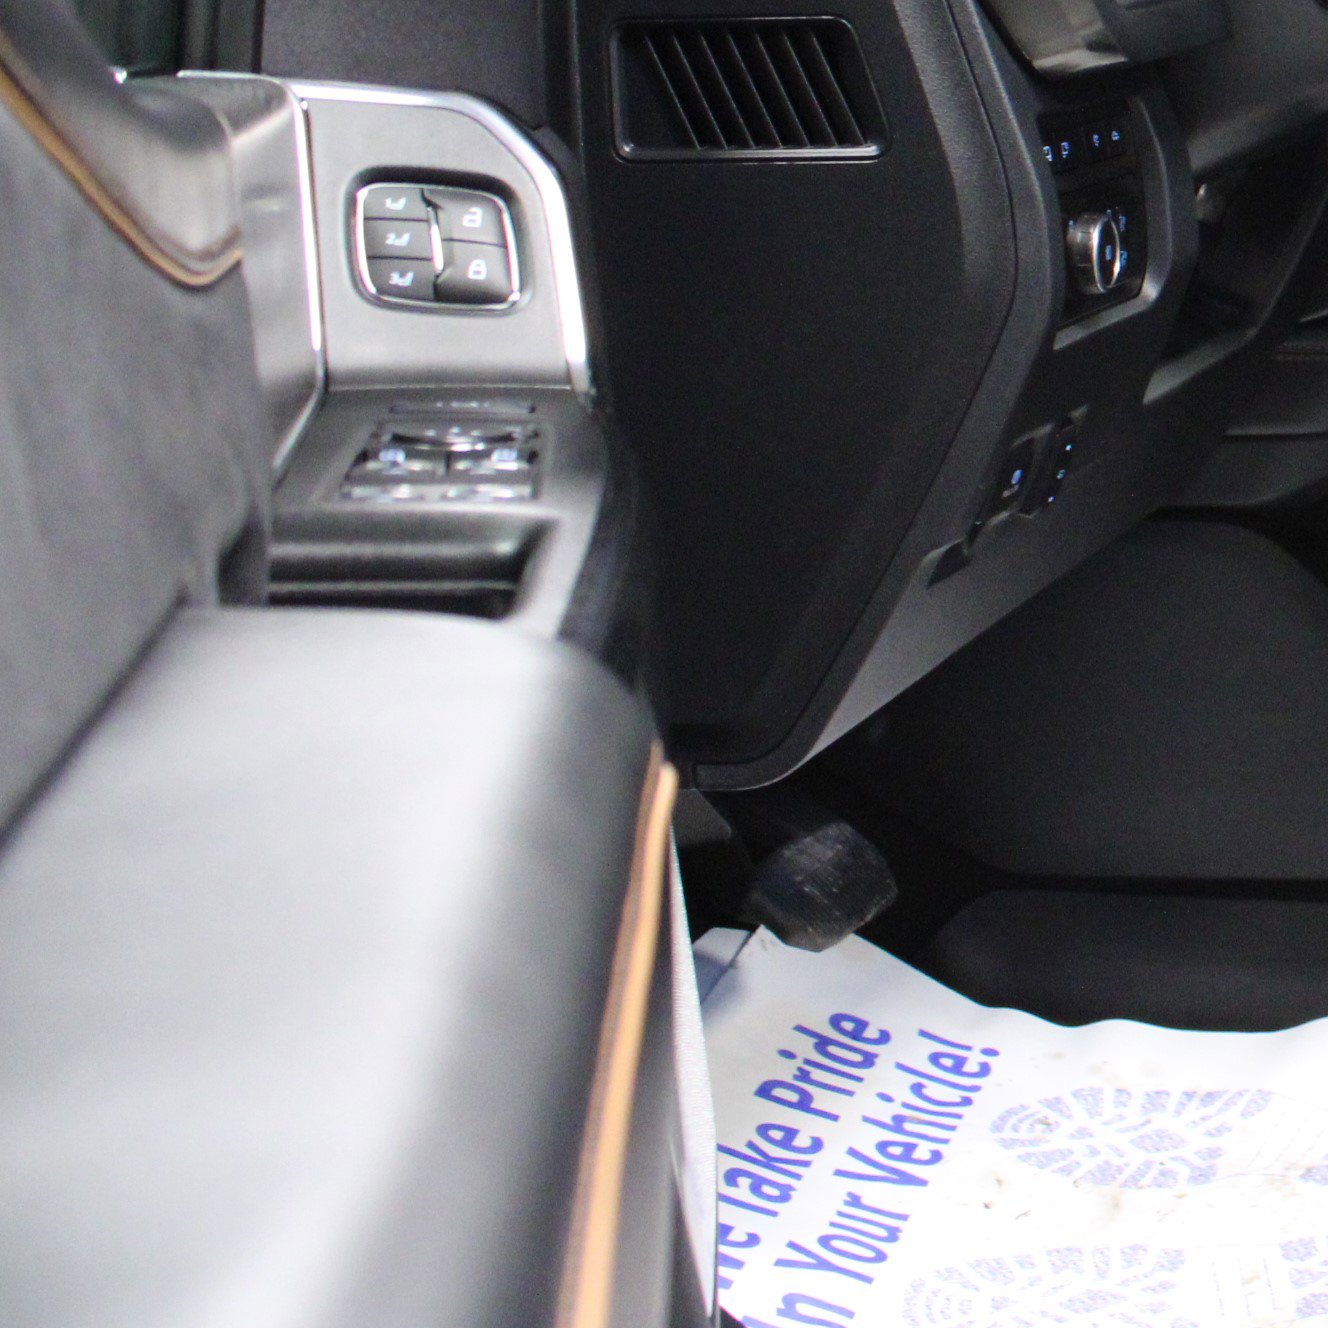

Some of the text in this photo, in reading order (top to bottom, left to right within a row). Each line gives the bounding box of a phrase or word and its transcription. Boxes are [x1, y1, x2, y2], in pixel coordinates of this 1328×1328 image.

[754, 1012, 892, 1122] Pride
[741, 1028, 1000, 1328] n Your Vehicle!
